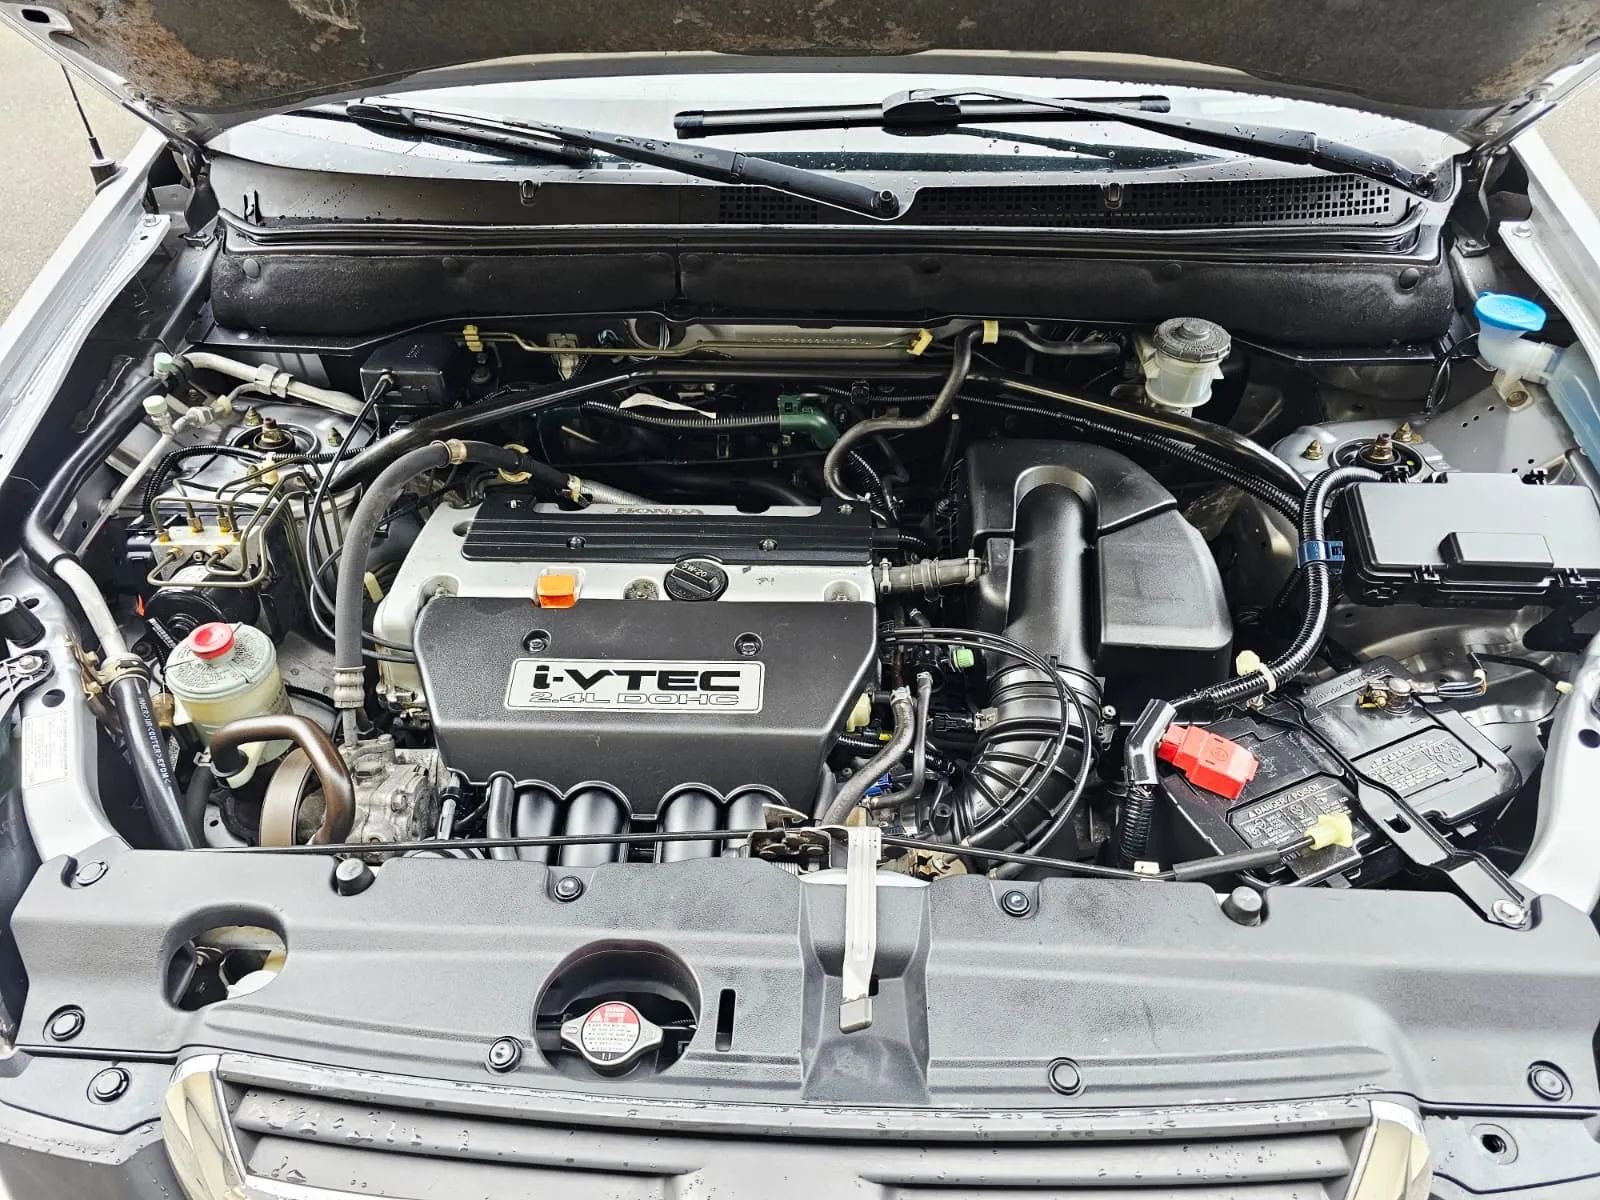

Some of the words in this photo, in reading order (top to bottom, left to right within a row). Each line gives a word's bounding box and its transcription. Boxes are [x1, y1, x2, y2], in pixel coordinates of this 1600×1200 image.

[615, 507, 705, 516] HONDA
[681, 562, 708, 577] 5W-20
[533, 665, 741, 692] i-VTEC
[529, 691, 610, 704] 2.4L
[617, 693, 739, 705] DOHC
[1254, 797, 1287, 815] DANGER
[1291, 783, 1322, 801] POISON
